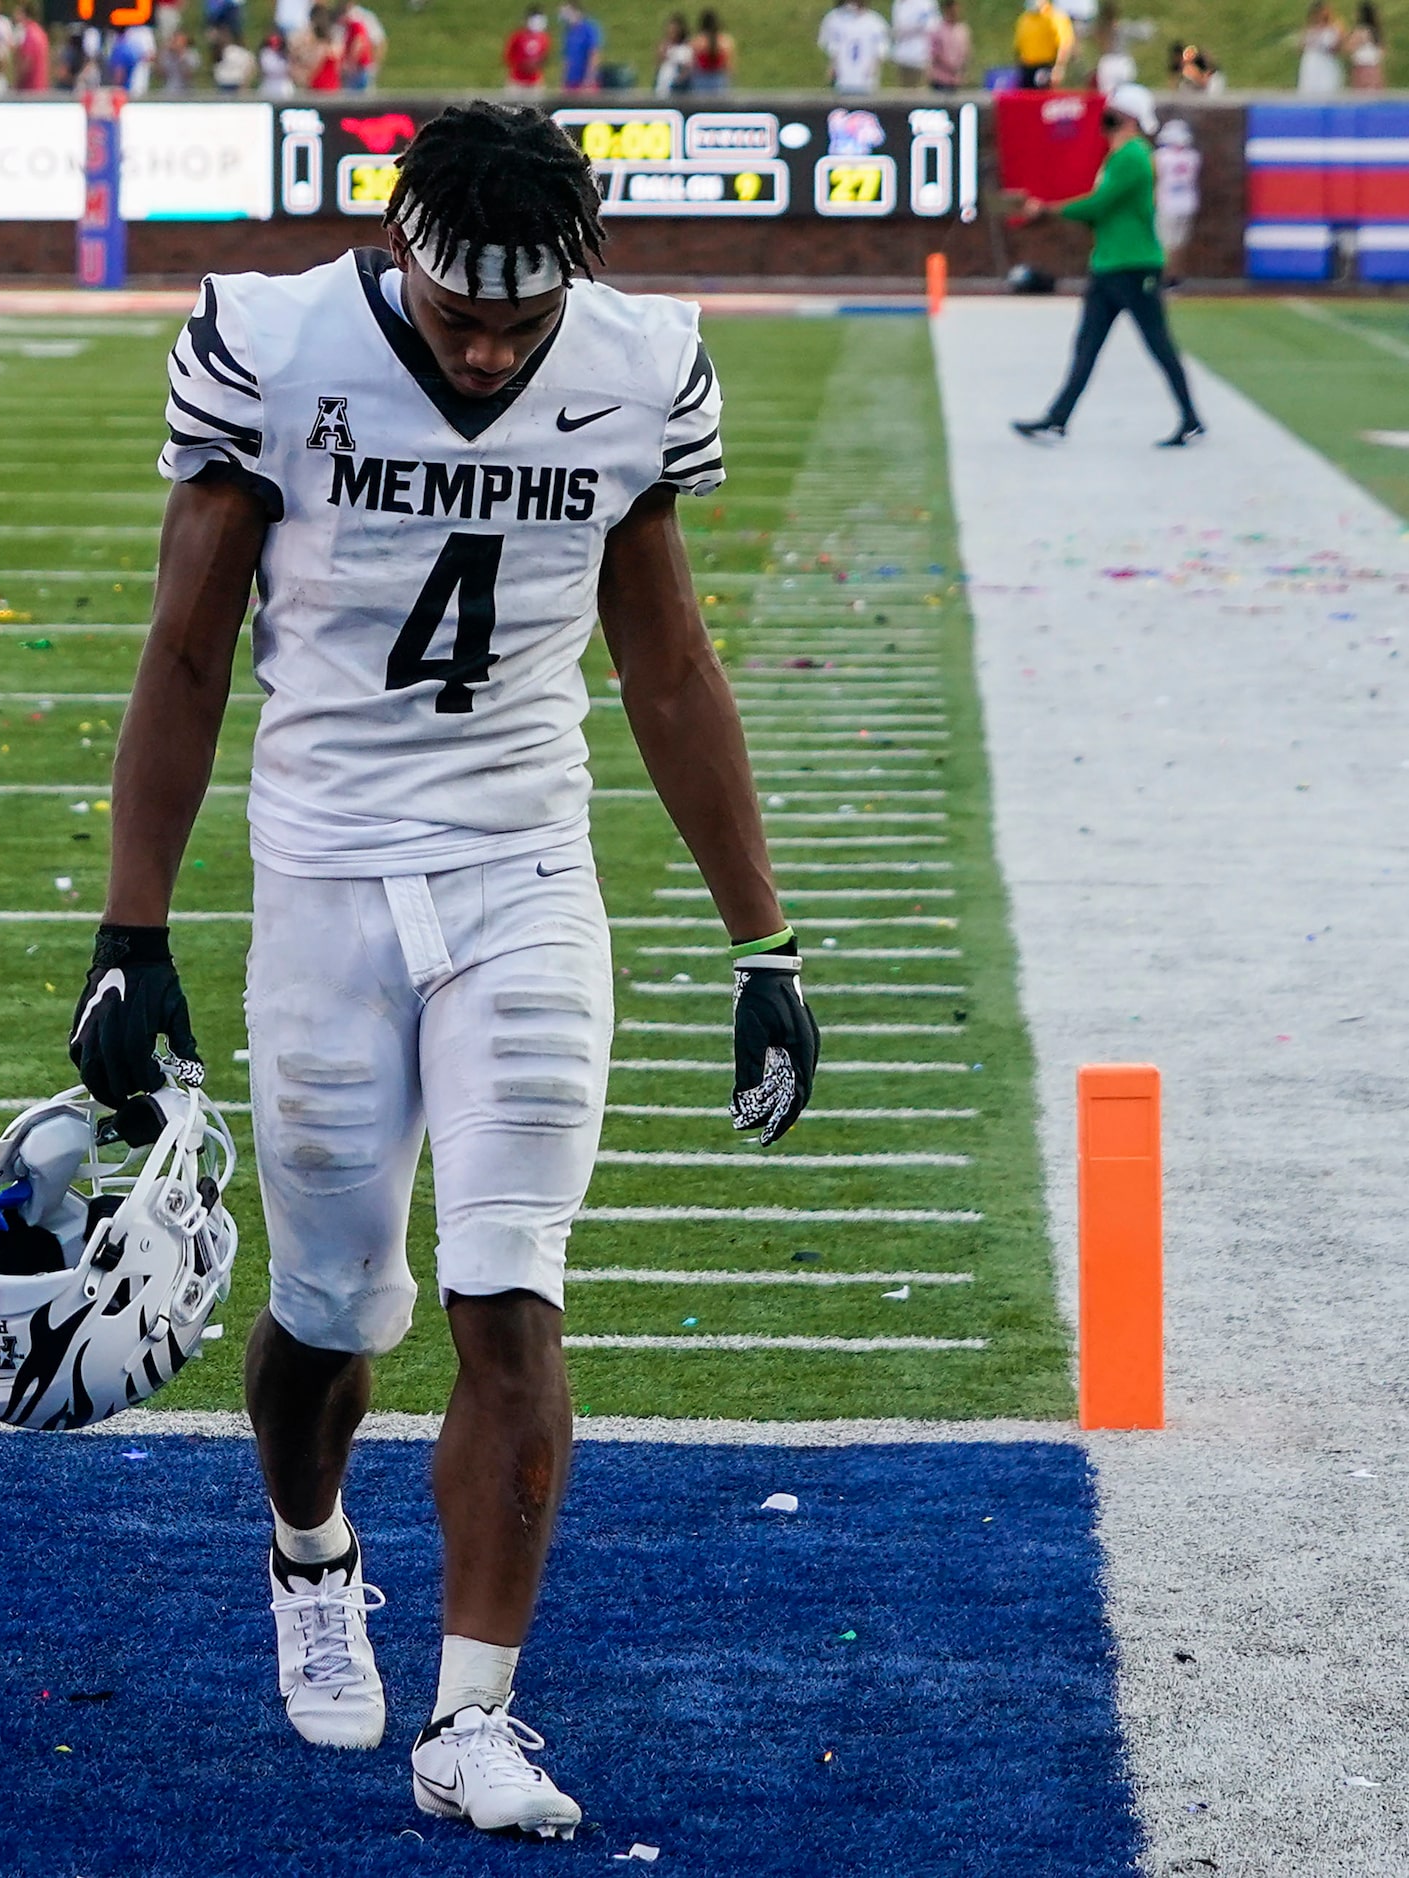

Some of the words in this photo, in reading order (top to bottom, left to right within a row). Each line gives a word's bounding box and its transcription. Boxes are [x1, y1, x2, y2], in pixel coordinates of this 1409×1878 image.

[583, 120, 671, 161] 0:00
[734, 172, 762, 201] 9
[829, 164, 882, 207] 27
[327, 452, 600, 521] MEMPHIS
[384, 531, 506, 714] 4
